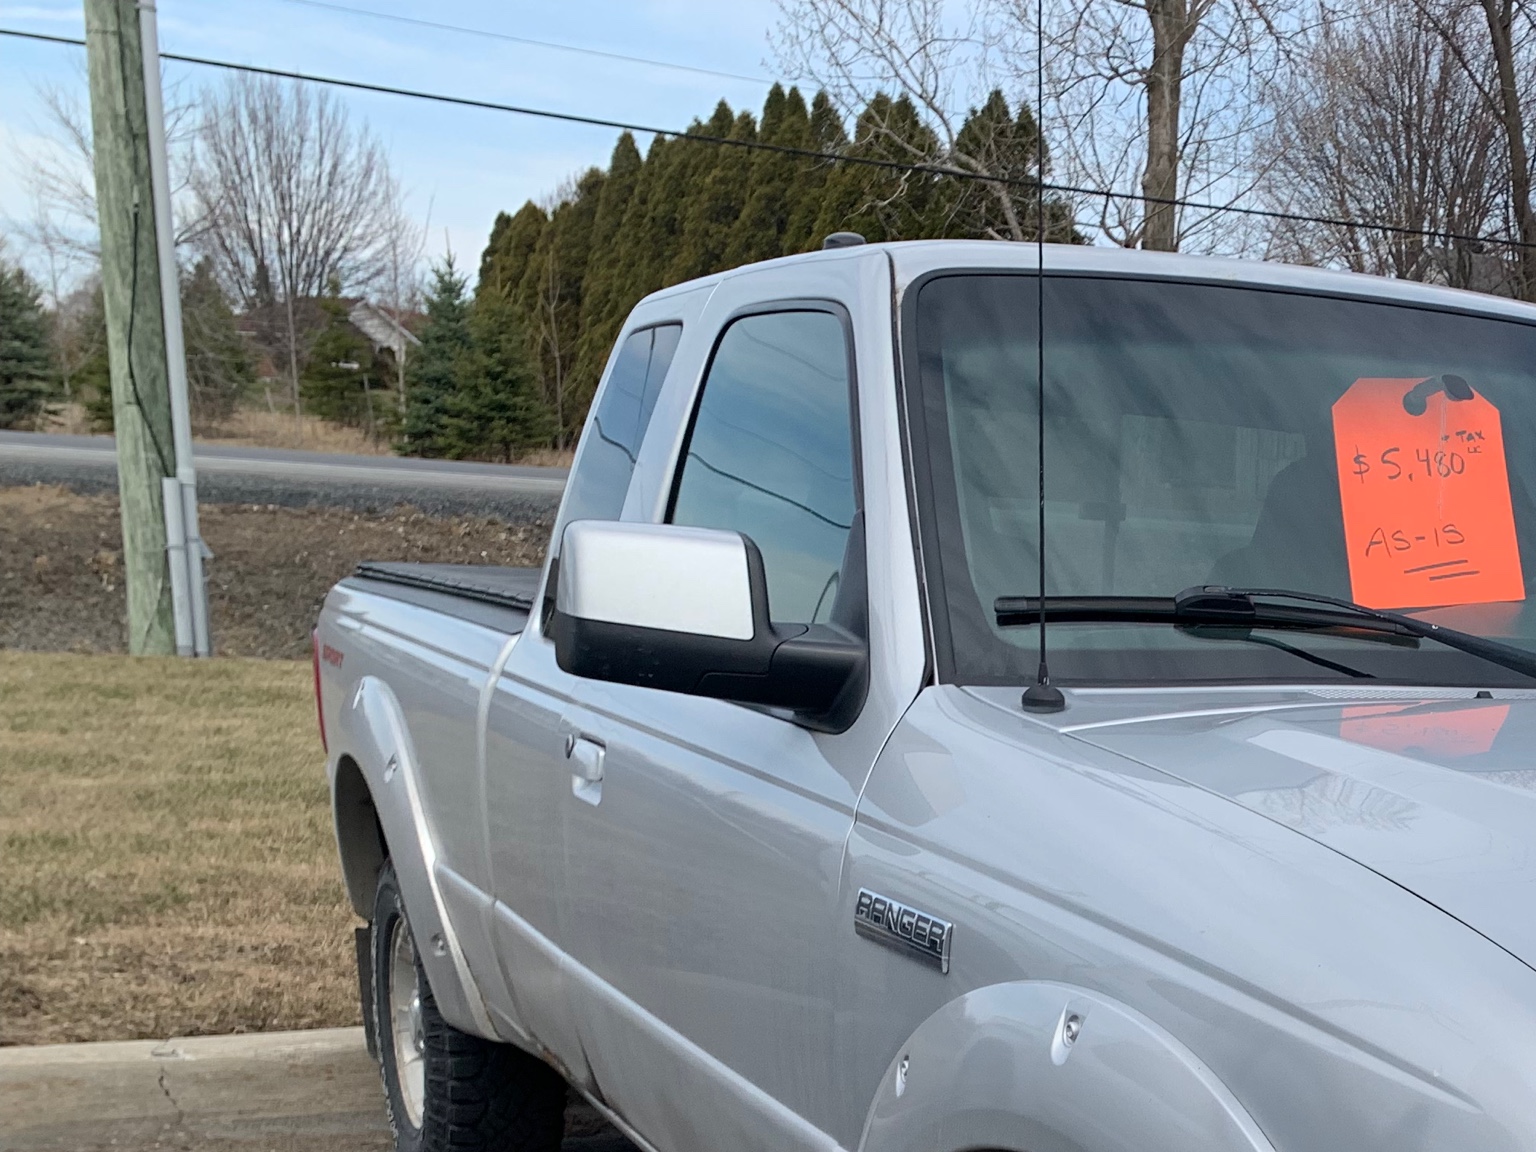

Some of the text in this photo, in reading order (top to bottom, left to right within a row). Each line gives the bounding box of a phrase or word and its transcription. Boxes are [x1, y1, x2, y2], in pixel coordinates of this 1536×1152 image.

[1455, 430, 1485, 443] TAX
[1365, 523, 1466, 558] AS-IS
[857, 890, 947, 953] RANGER
